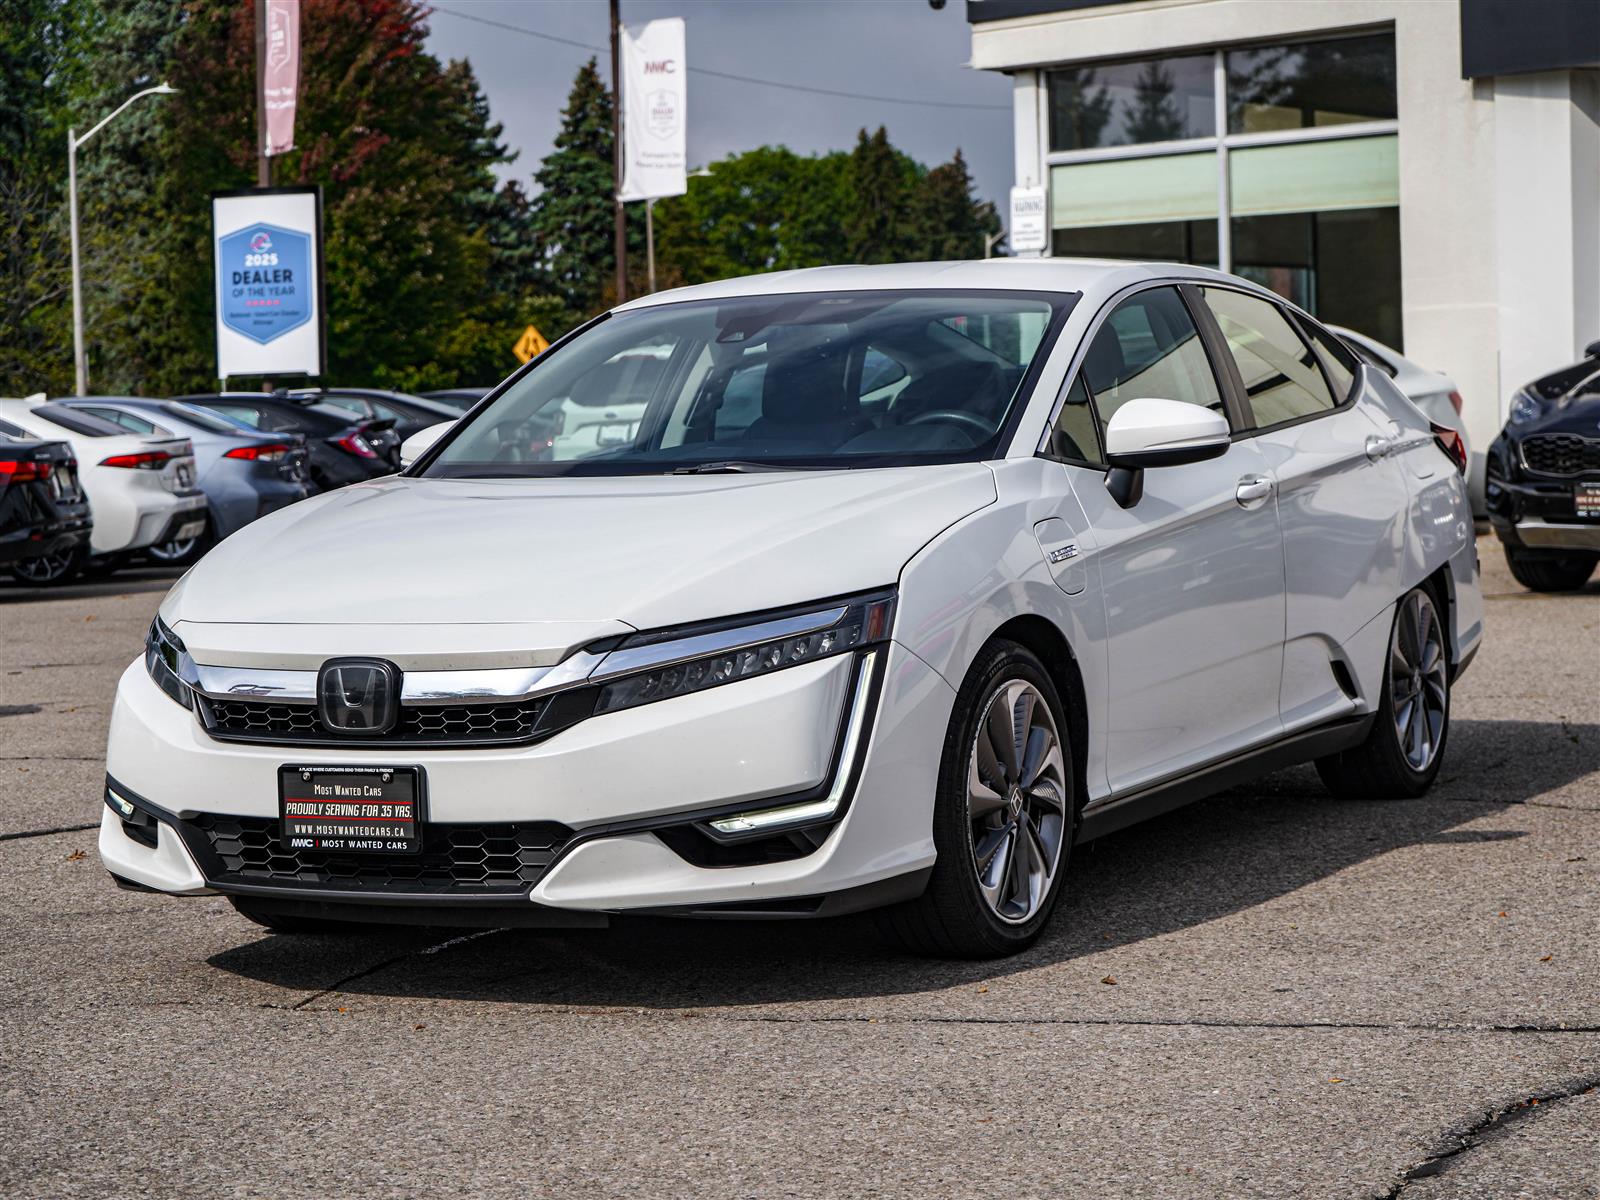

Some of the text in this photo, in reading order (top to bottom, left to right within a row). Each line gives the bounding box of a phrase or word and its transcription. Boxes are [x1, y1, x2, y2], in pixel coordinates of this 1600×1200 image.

[244, 253, 279, 267] 2025
[232, 269, 293, 285] DEALER
[232, 286, 296, 298] OF THE YEAR
[286, 802, 413, 818] PROUDLY SERVING FOR 35 YRS.
[294, 824, 405, 837] WWW.MOSTWANTEDCARS.CA
[321, 839, 345, 848] MOST
[348, 840, 383, 849] WANTED
[386, 841, 408, 850] CARS
